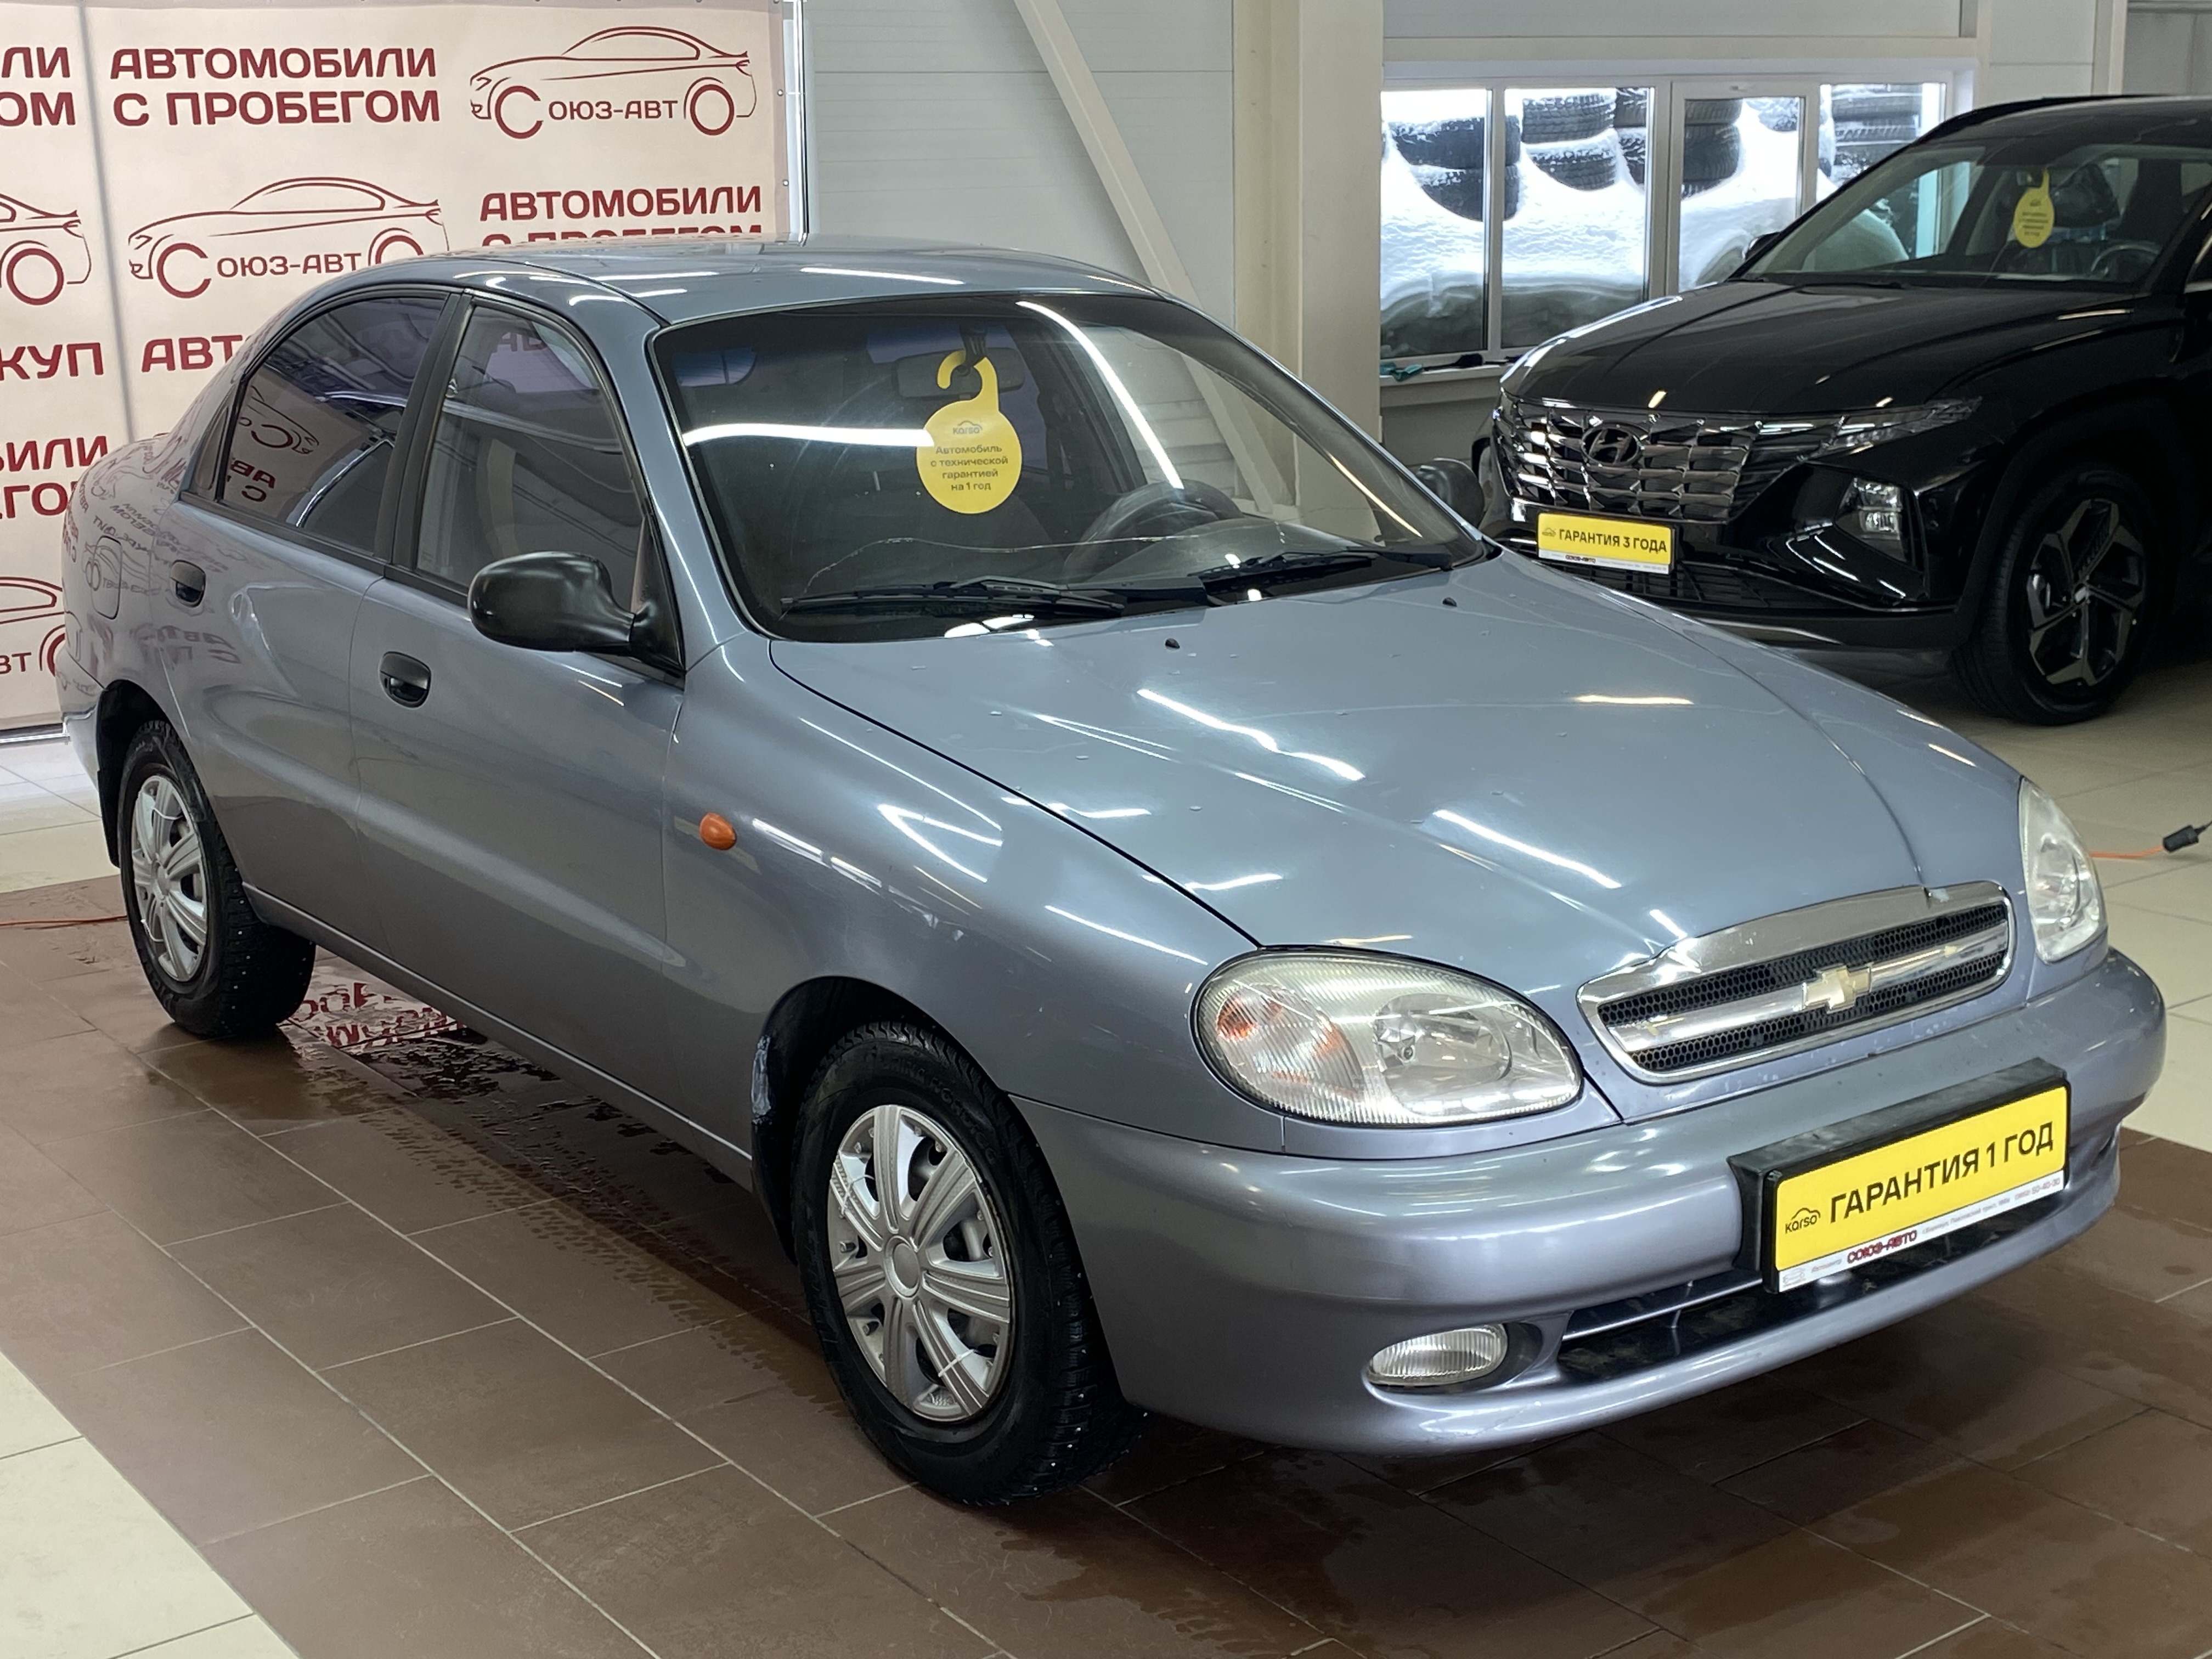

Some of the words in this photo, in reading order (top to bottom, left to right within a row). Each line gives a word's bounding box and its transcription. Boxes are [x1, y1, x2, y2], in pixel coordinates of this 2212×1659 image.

[110, 48, 436, 79] АВТОМОБИЛИ
[114, 93, 150, 126] С
[167, 90, 439, 125] ПРОБЕГОМ
[481, 186, 761, 221] АВТОМОБИЛИ
[936, 444, 1002, 454] Автомобиль
[940, 456, 1008, 466] технической
[943, 469, 998, 480] гарантией
[1559, 529, 1620, 547] ГАРАНТИЯ
[1623, 537, 1630, 548] 3
[1633, 538, 1667, 554] ГОДА
[1830, 1147, 1979, 1223] ГАРАНТИЯ
[1986, 1142, 1995, 1167] 1
[2004, 1121, 2053, 1163] ГОД
